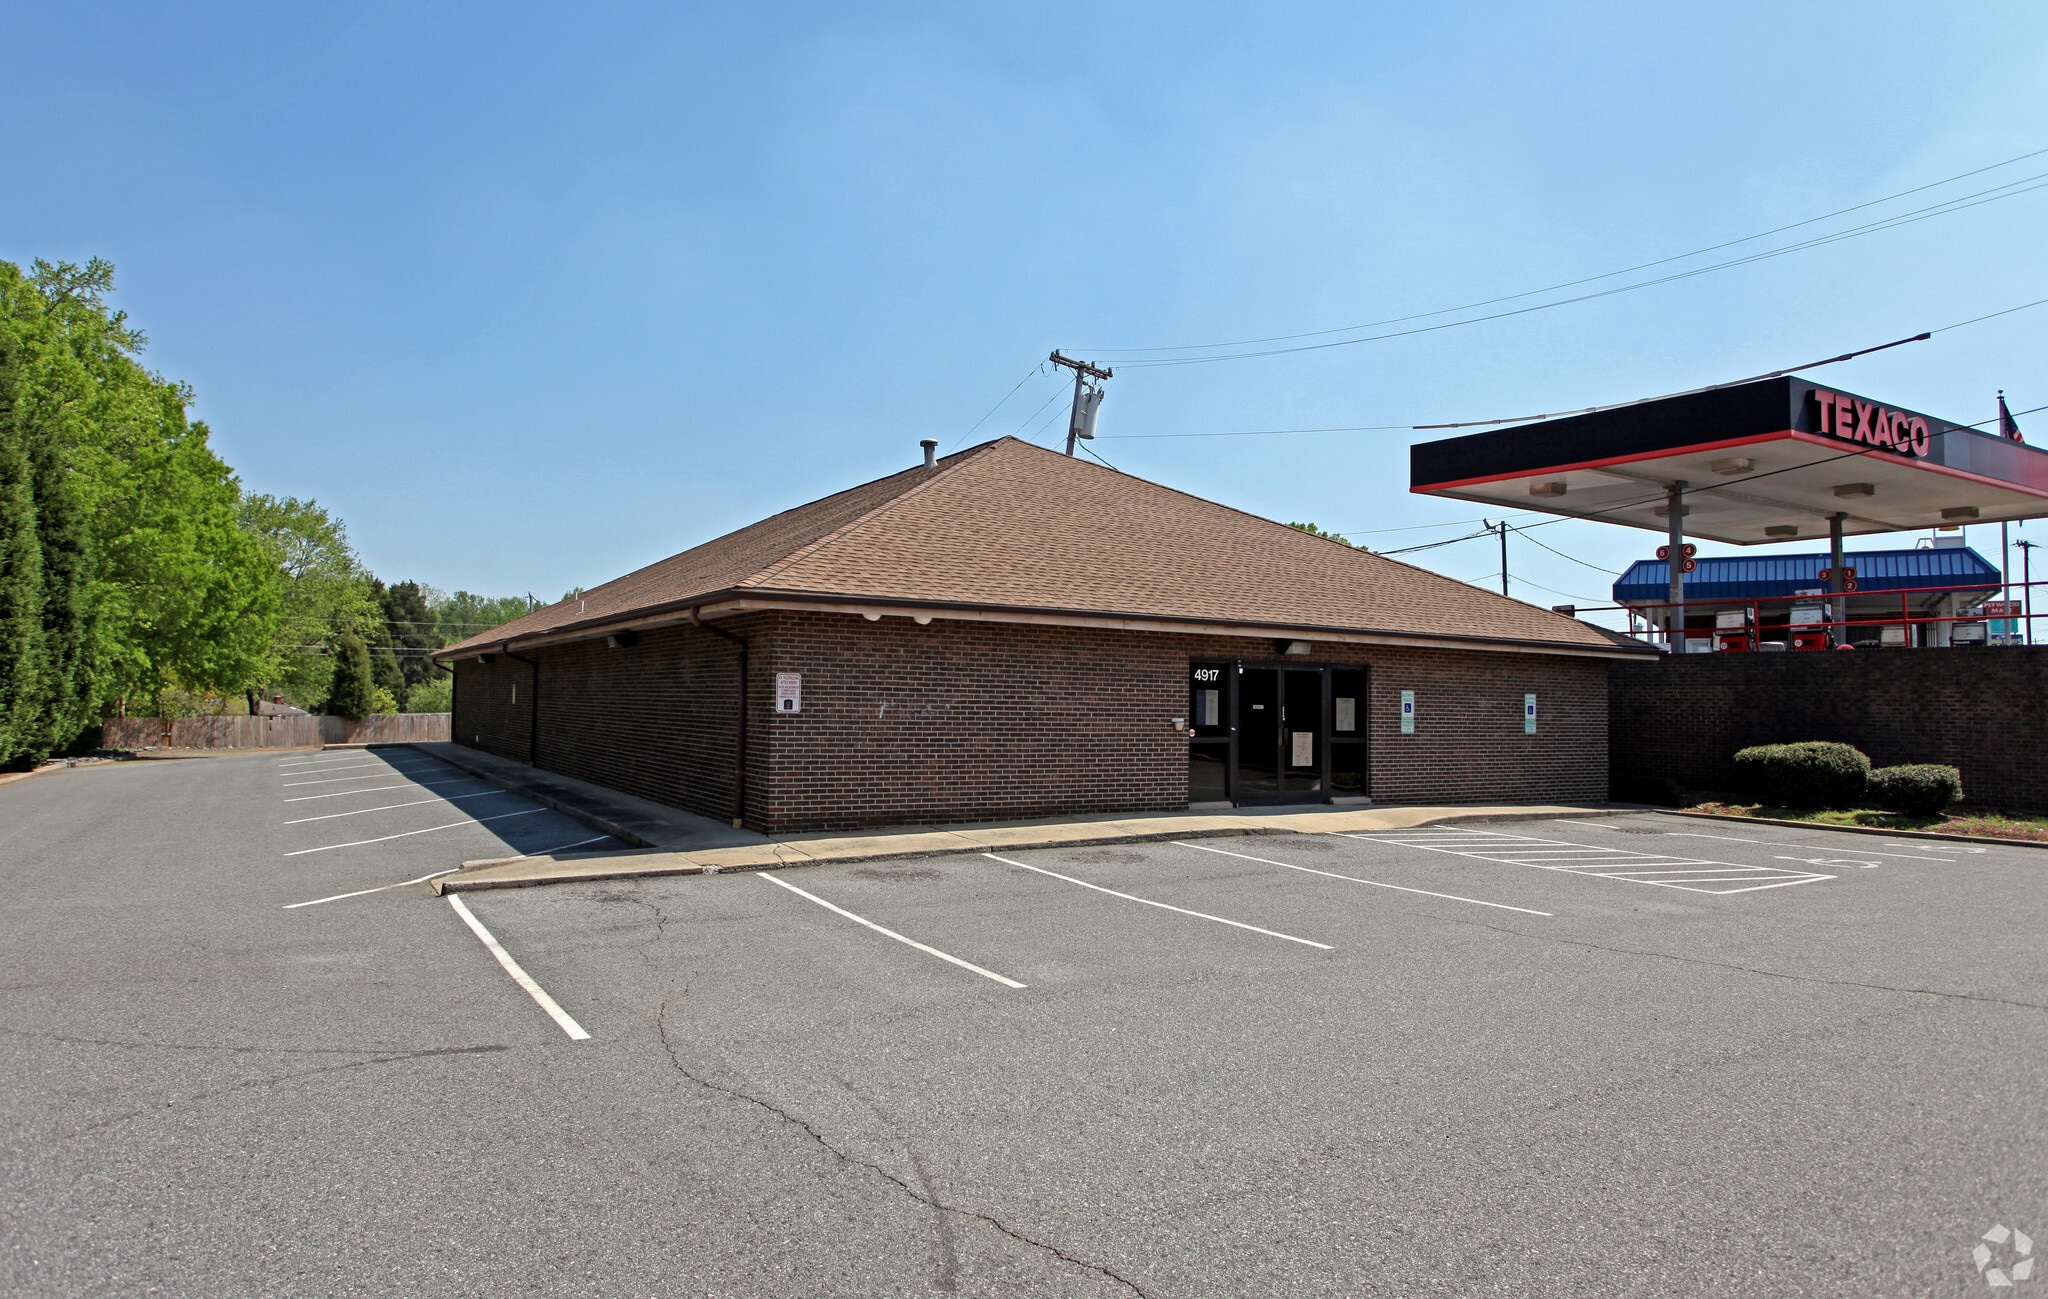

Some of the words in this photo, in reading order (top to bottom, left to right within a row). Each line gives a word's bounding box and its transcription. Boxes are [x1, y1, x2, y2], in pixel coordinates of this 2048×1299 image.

[1815, 389, 1931, 457] TEXACO
[1659, 549, 1665, 557] 6
[1686, 561, 1692, 569] 5
[1194, 669, 1219, 681] 4917
